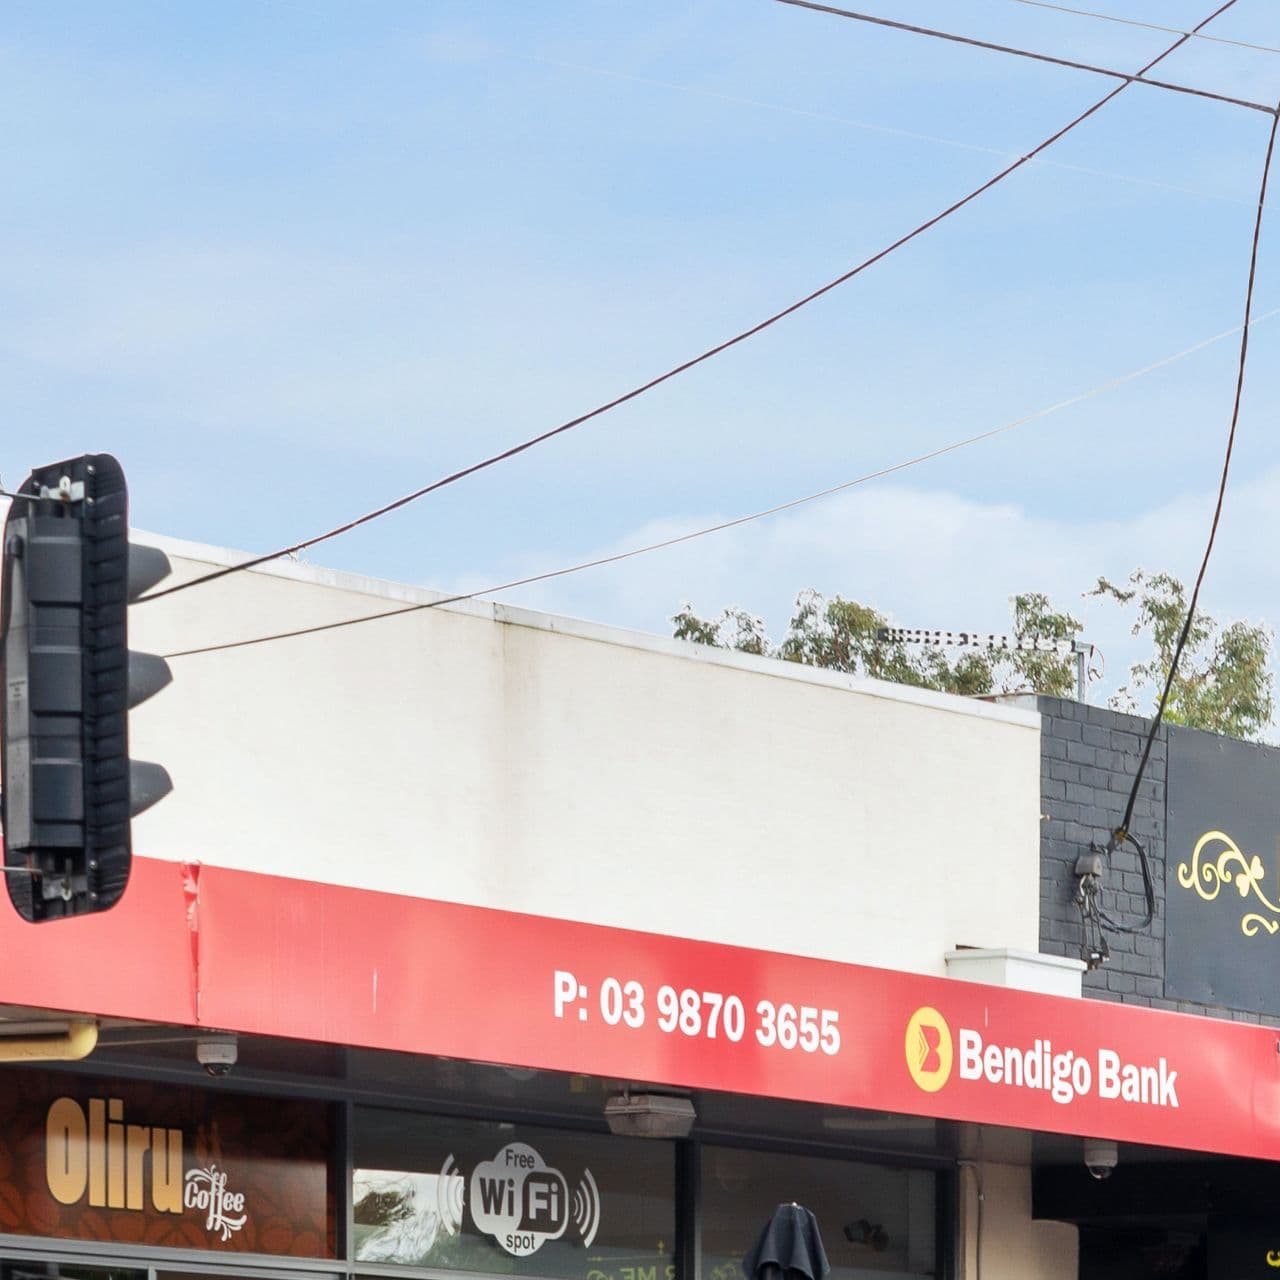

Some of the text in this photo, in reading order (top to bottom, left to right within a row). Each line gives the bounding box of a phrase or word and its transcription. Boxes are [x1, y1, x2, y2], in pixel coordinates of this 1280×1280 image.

[554, 970, 841, 1056] P: 03 9870 3655
[959, 1028, 1180, 1108] Bendigo Bank
[46, 1096, 183, 1214] Oliru
[505, 1149, 536, 1169] Free
[184, 1167, 246, 1238] Coffee
[479, 1176, 559, 1222] Wi Fi
[506, 1232, 535, 1253] spot
